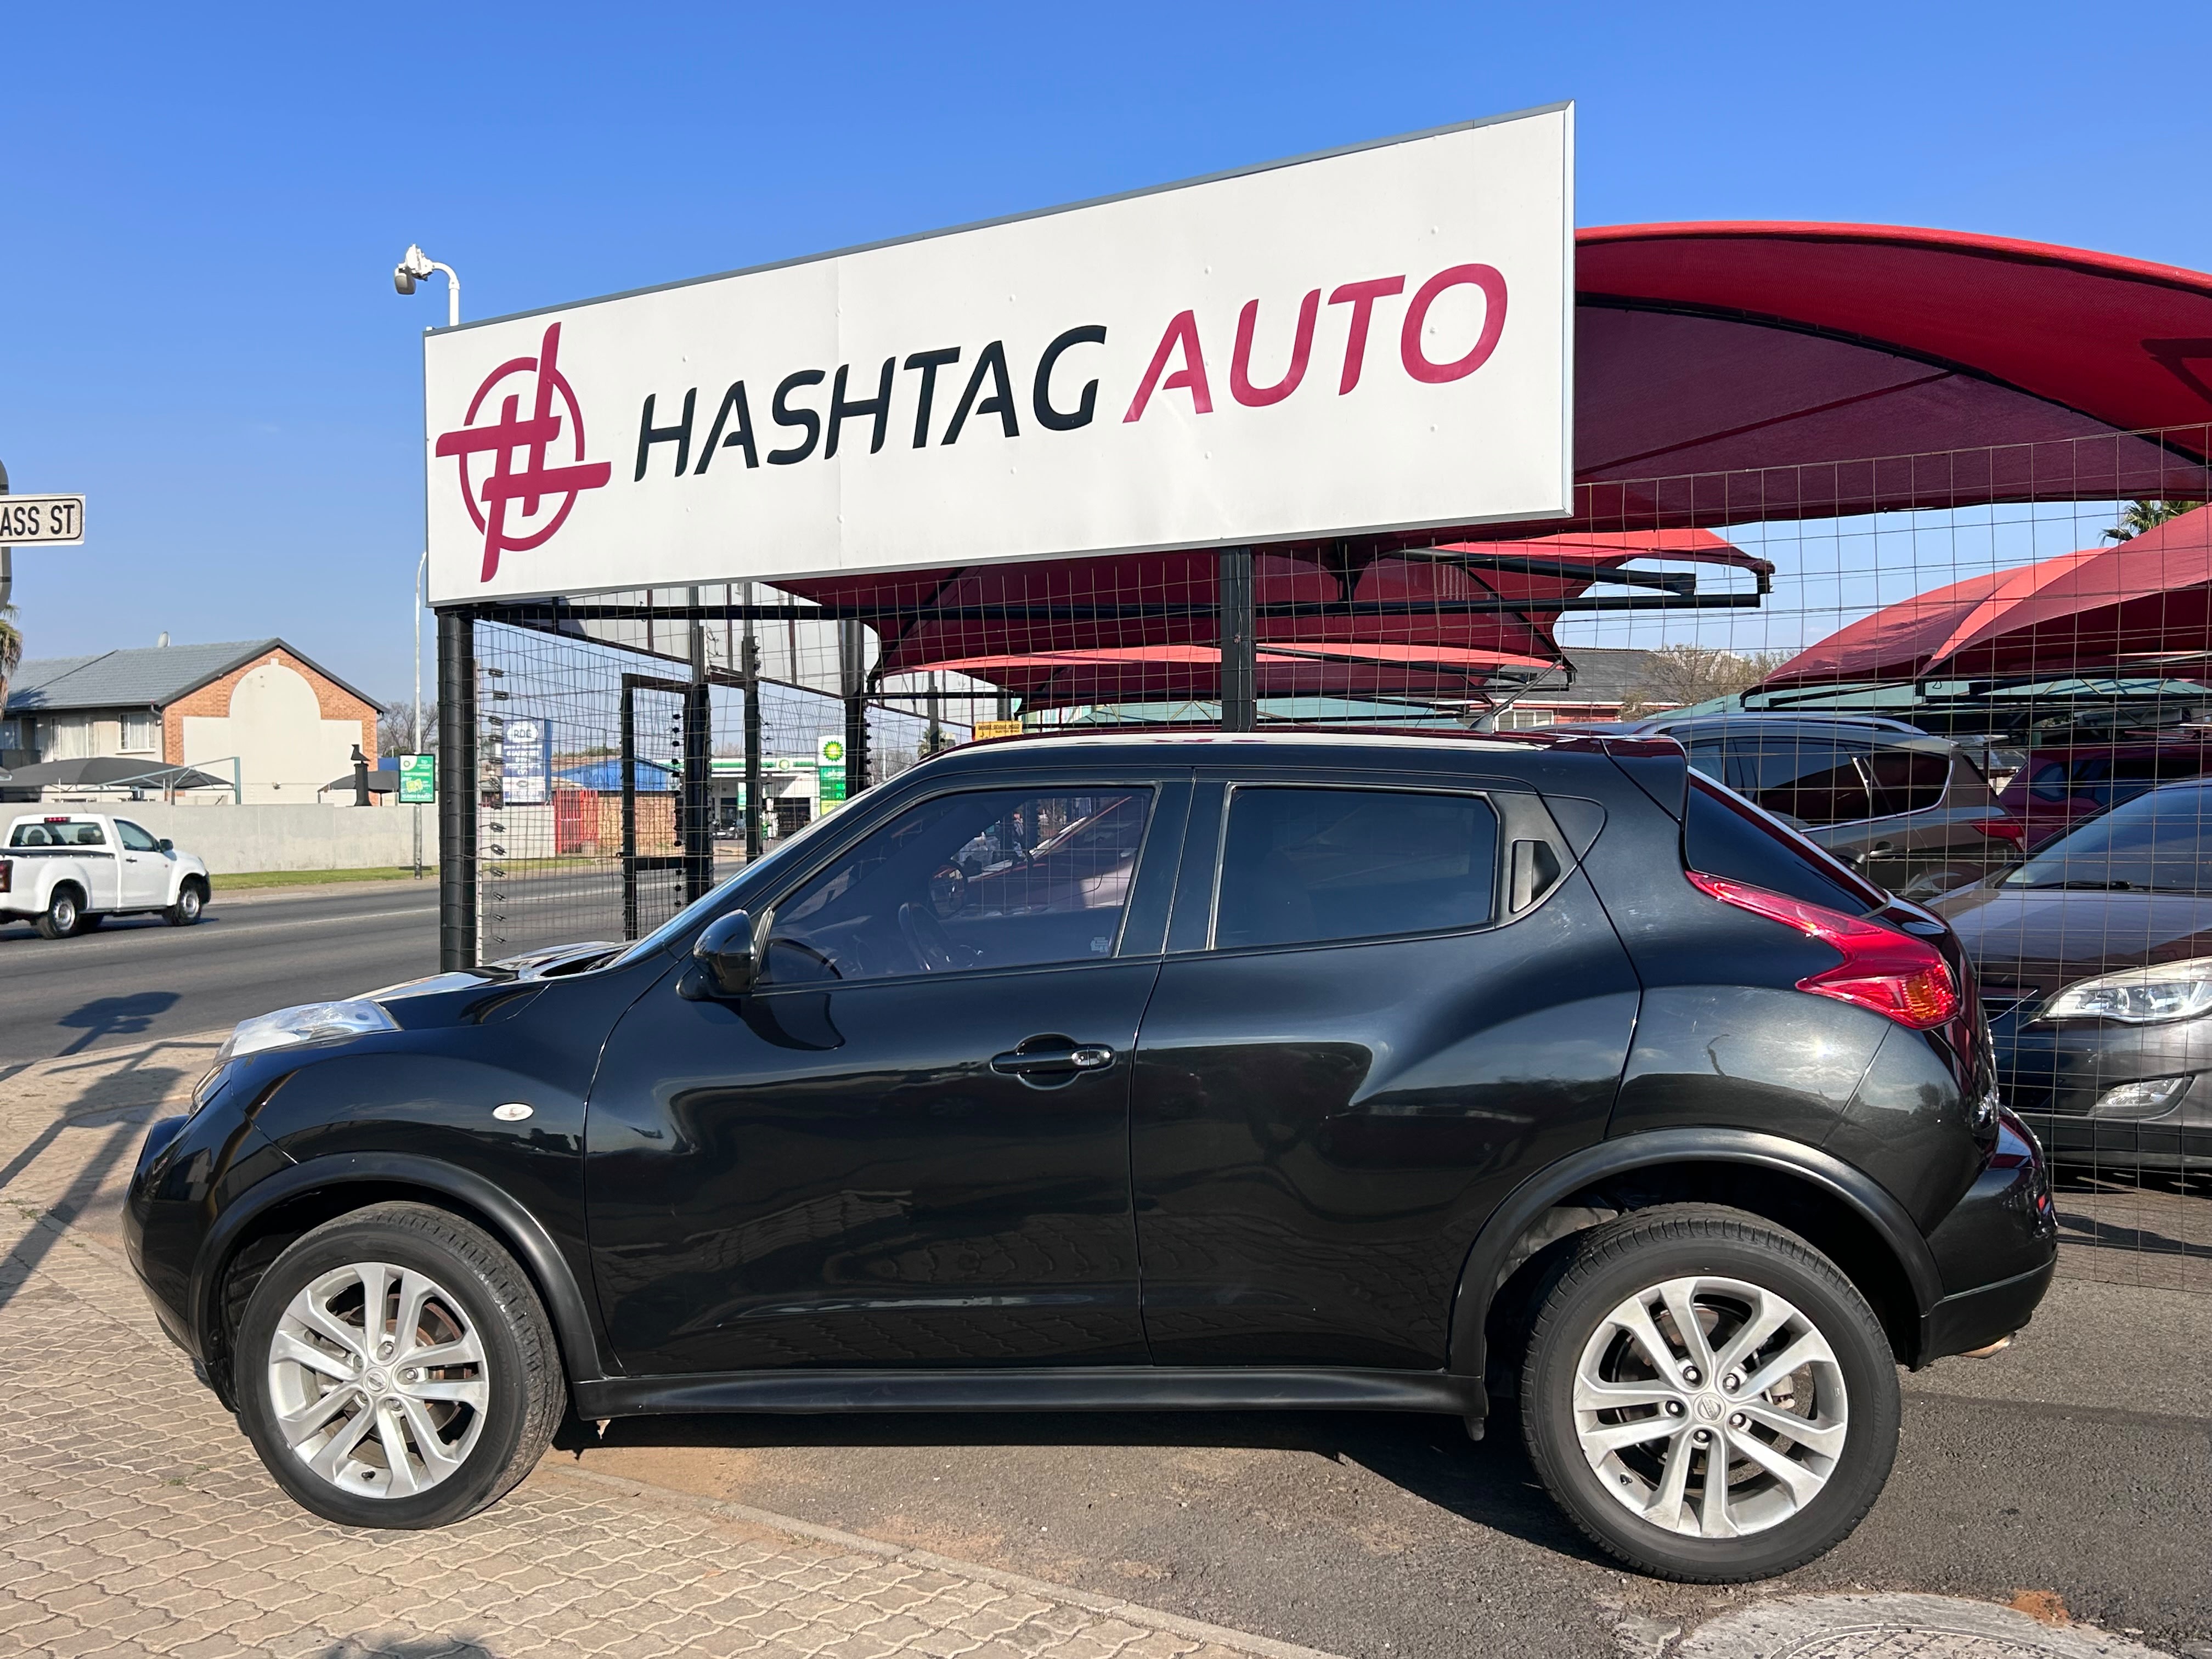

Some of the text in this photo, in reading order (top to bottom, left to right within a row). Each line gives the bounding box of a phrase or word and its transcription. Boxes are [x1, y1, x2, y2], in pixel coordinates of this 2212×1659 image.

[634, 263, 1508, 482] HASHTAG AUTO
[50, 504, 75, 534] ST
